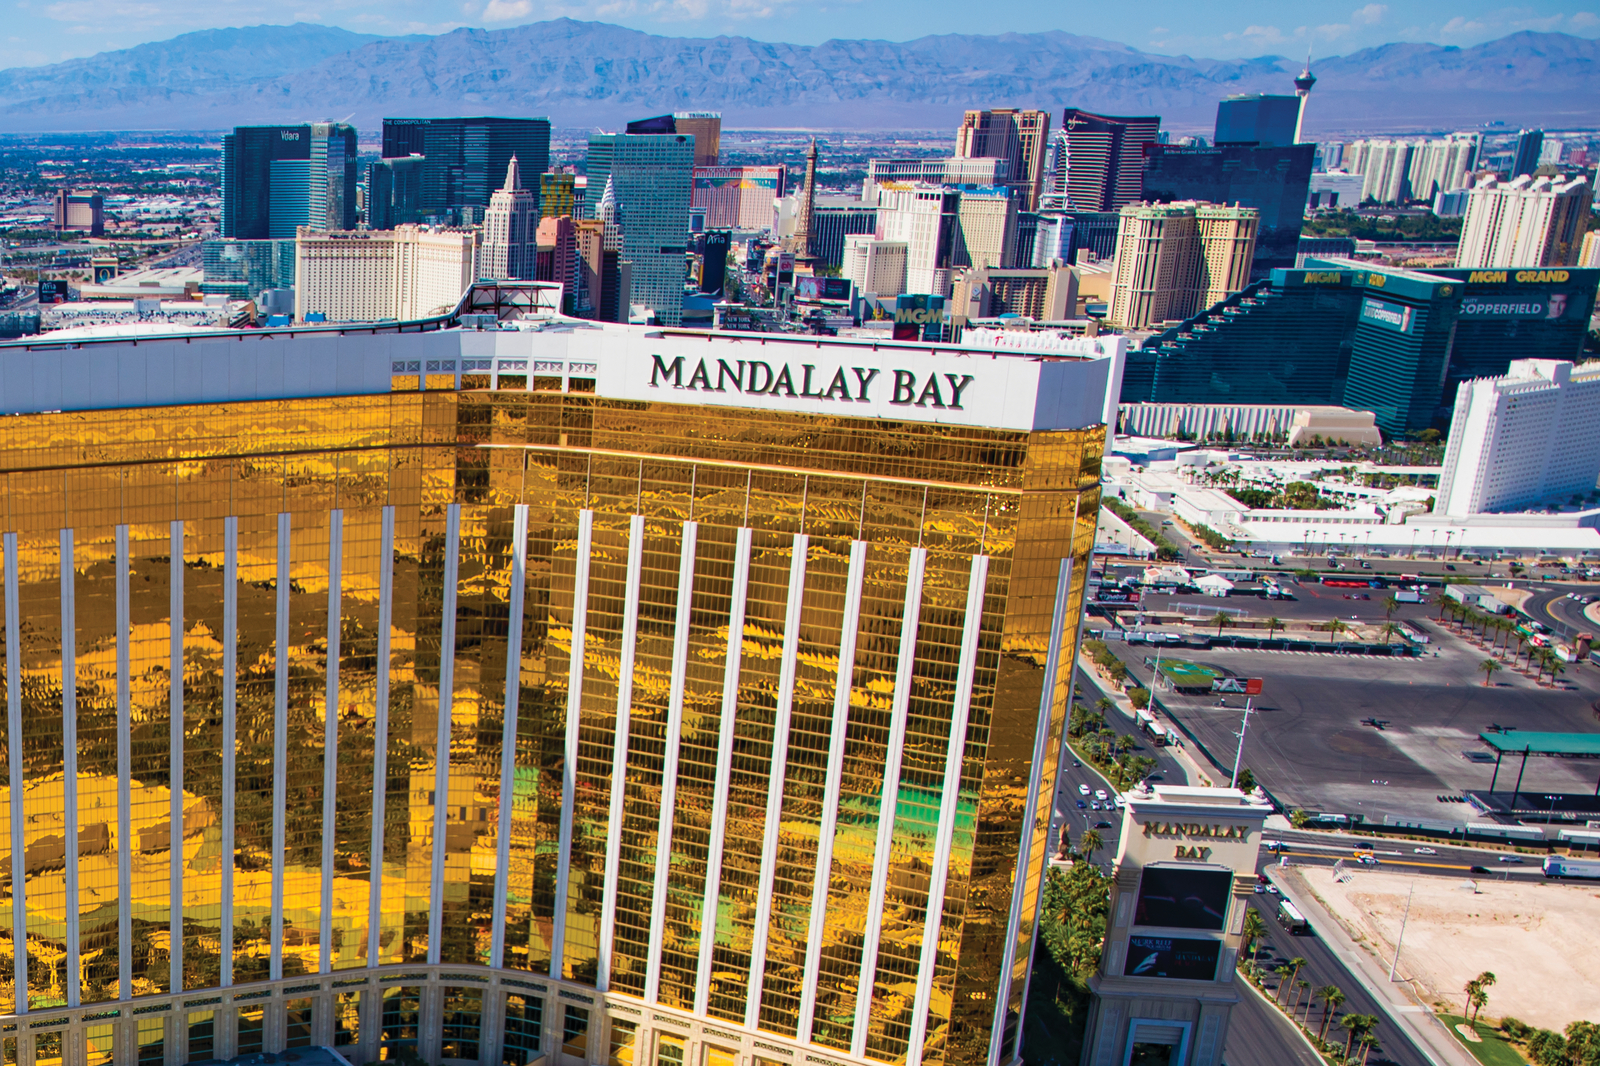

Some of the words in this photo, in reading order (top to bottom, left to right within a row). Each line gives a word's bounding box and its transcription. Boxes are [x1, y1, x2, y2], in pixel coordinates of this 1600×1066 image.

[281, 130, 299, 141] Vdara
[707, 234, 725, 245] Aria
[1304, 272, 1341, 284] MGM
[1468, 271, 1508, 283] MGM
[1515, 270, 1570, 283] GRAND
[895, 307, 943, 324] MGM
[648, 354, 879, 403] MANDALAY
[890, 369, 974, 410] BAY
[1142, 821, 1249, 839] MANDALAY
[1174, 845, 1209, 859] BAY
